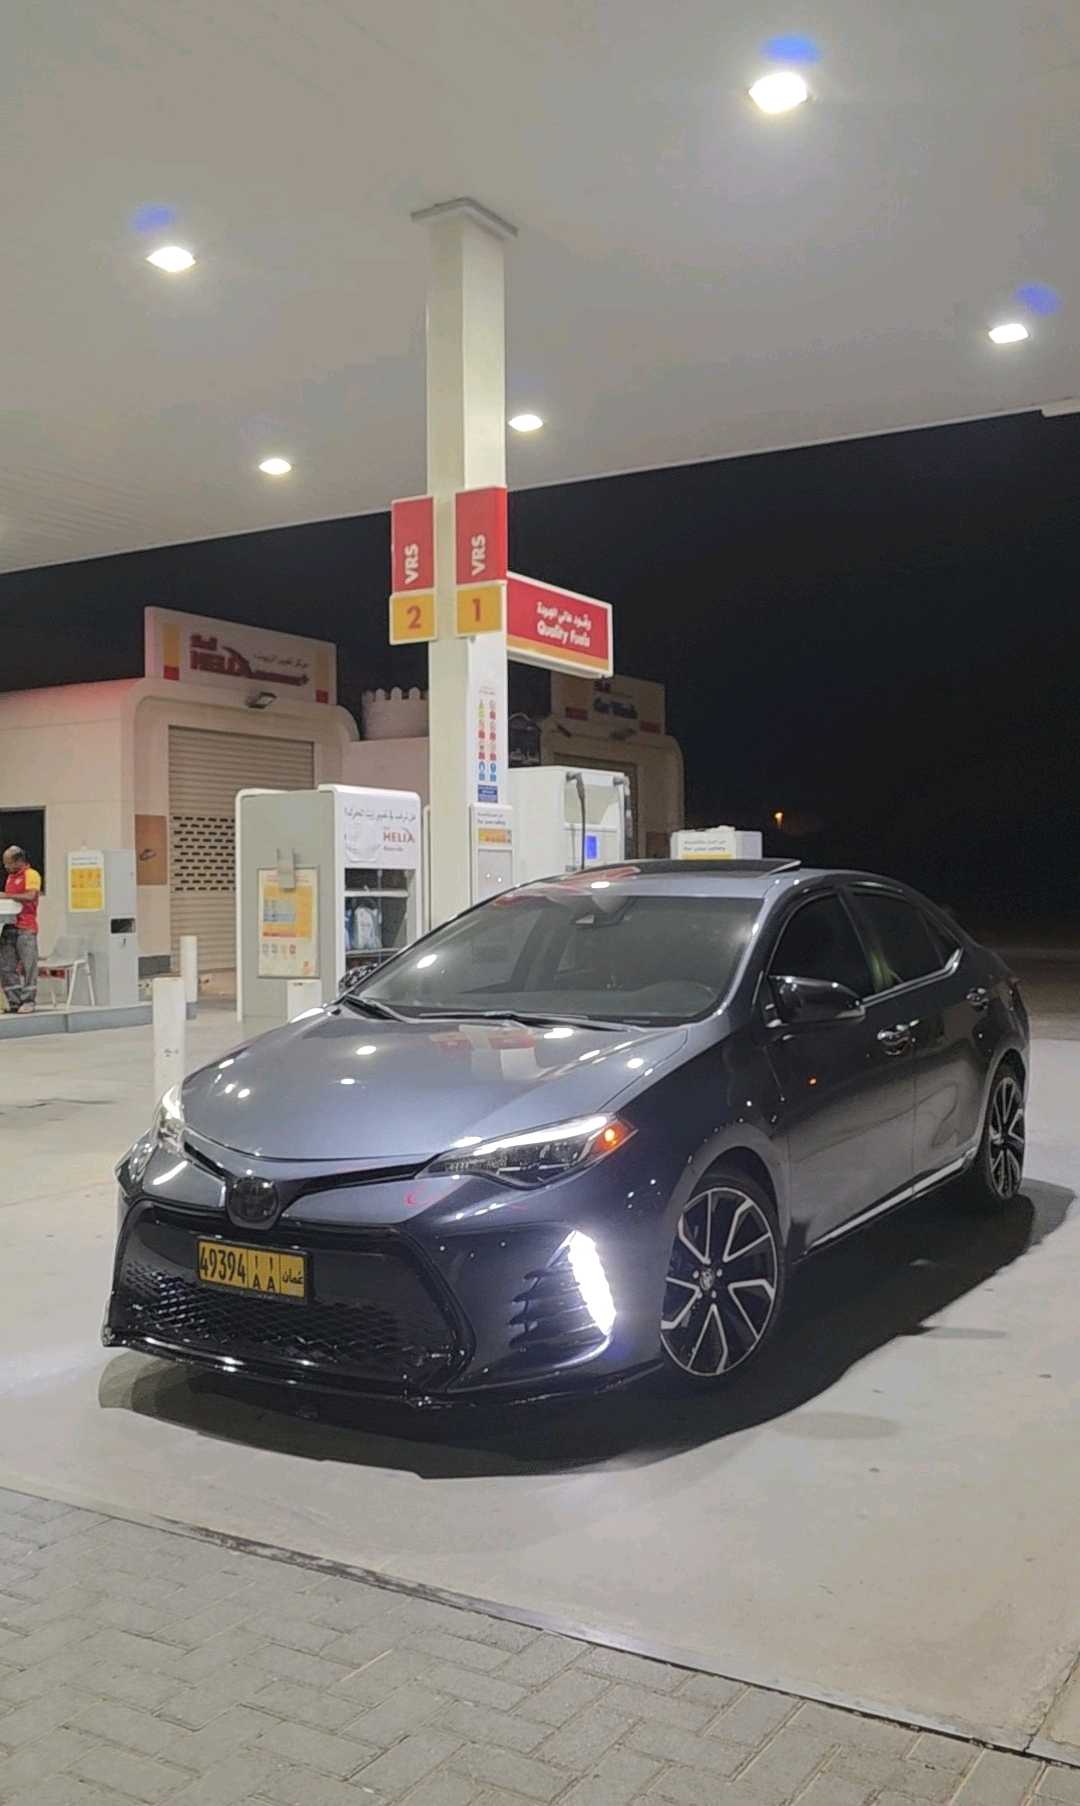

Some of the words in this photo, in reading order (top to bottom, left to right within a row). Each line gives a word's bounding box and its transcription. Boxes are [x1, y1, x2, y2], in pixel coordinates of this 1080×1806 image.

[404, 543, 419, 584] VRS
[472, 534, 486, 576] VRS
[406, 604, 422, 629] 2
[472, 598, 481, 623] 1
[537, 619, 569, 645] Quality
[200, 1246, 246, 1284] 49394
